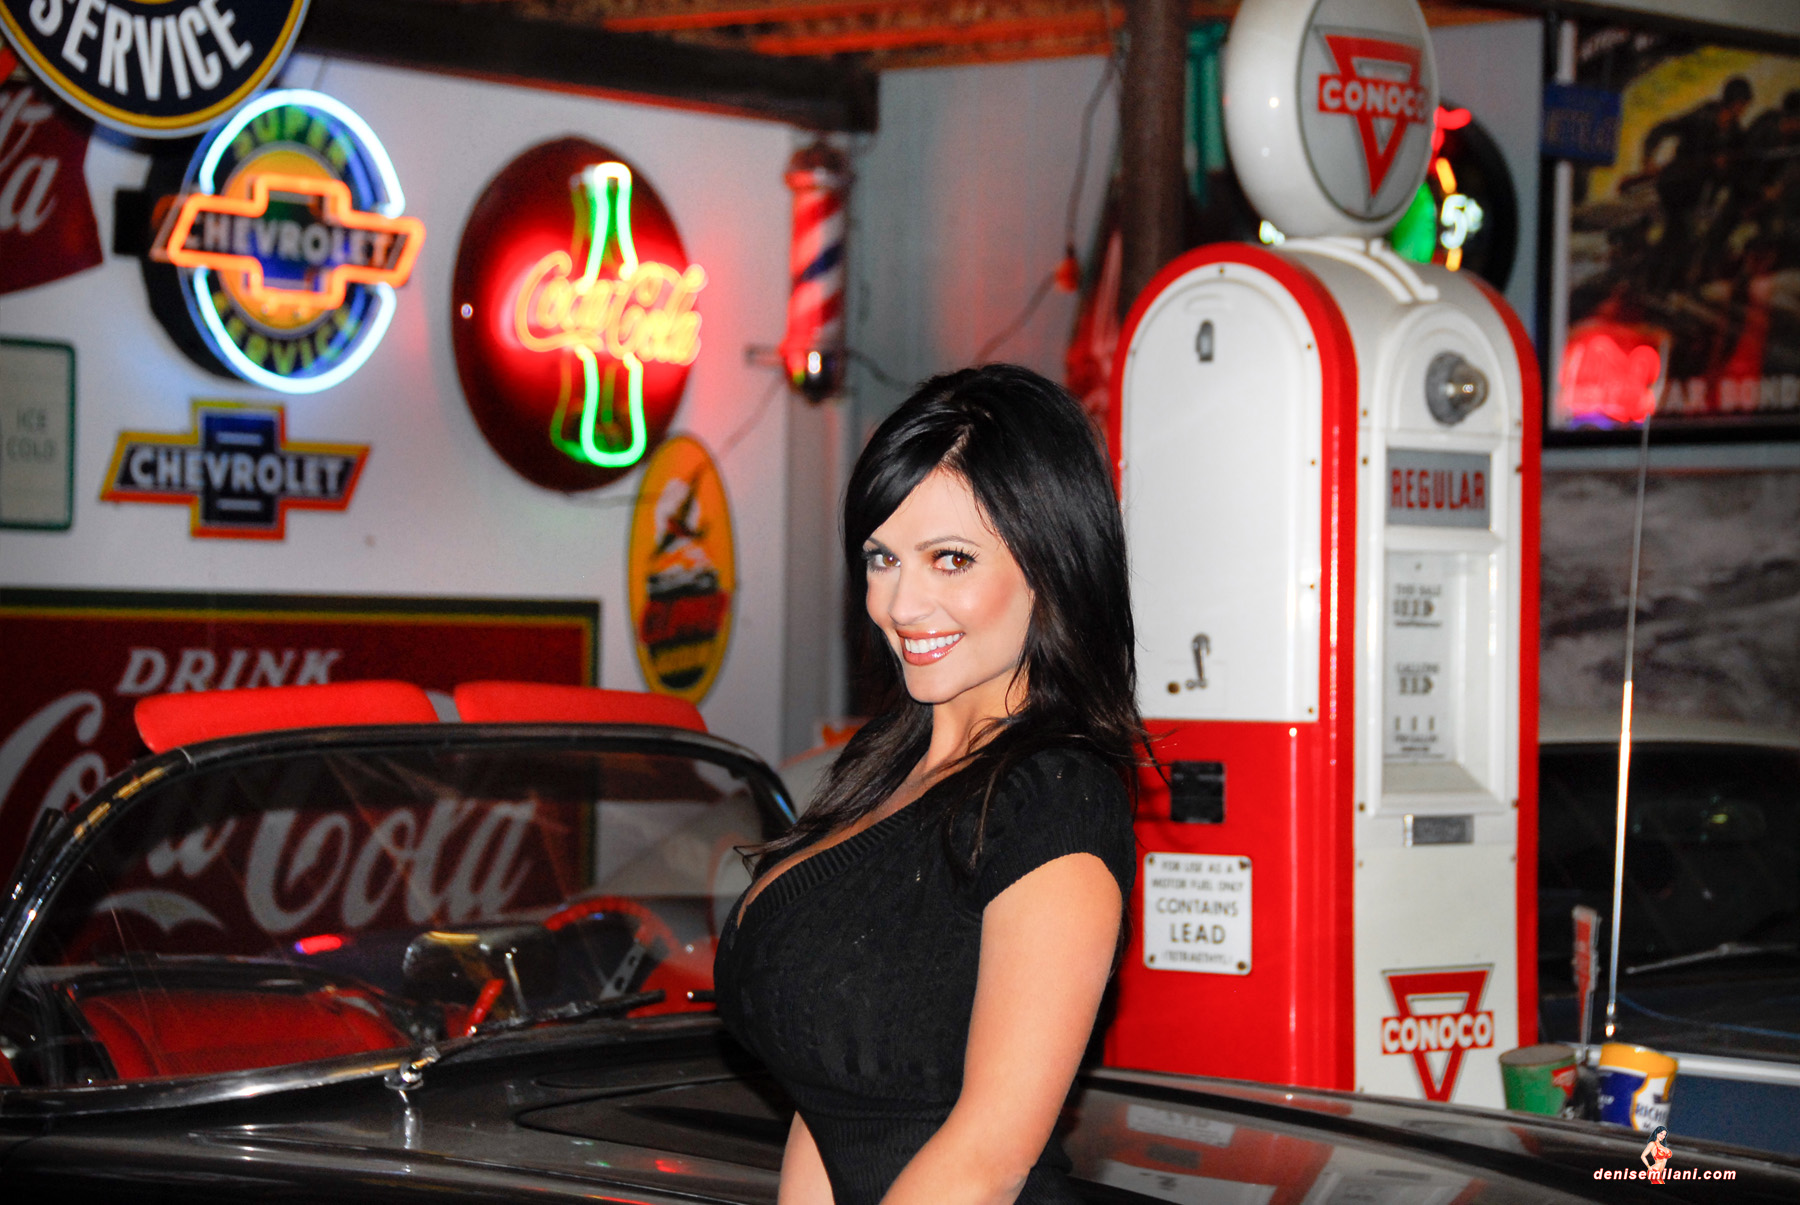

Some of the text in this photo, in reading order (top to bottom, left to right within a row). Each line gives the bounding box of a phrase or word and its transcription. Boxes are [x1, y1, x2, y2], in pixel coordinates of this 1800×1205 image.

[30, 0, 253, 100] SERVICE
[129, 446, 345, 495] CHEVROLET
[1391, 469, 1486, 510] REGULAR
[116, 648, 344, 694] DRINK
[1155, 897, 1238, 917] CONTAINS
[1170, 922, 1226, 945] LEAD
[1384, 1013, 1492, 1053] CONOCO
